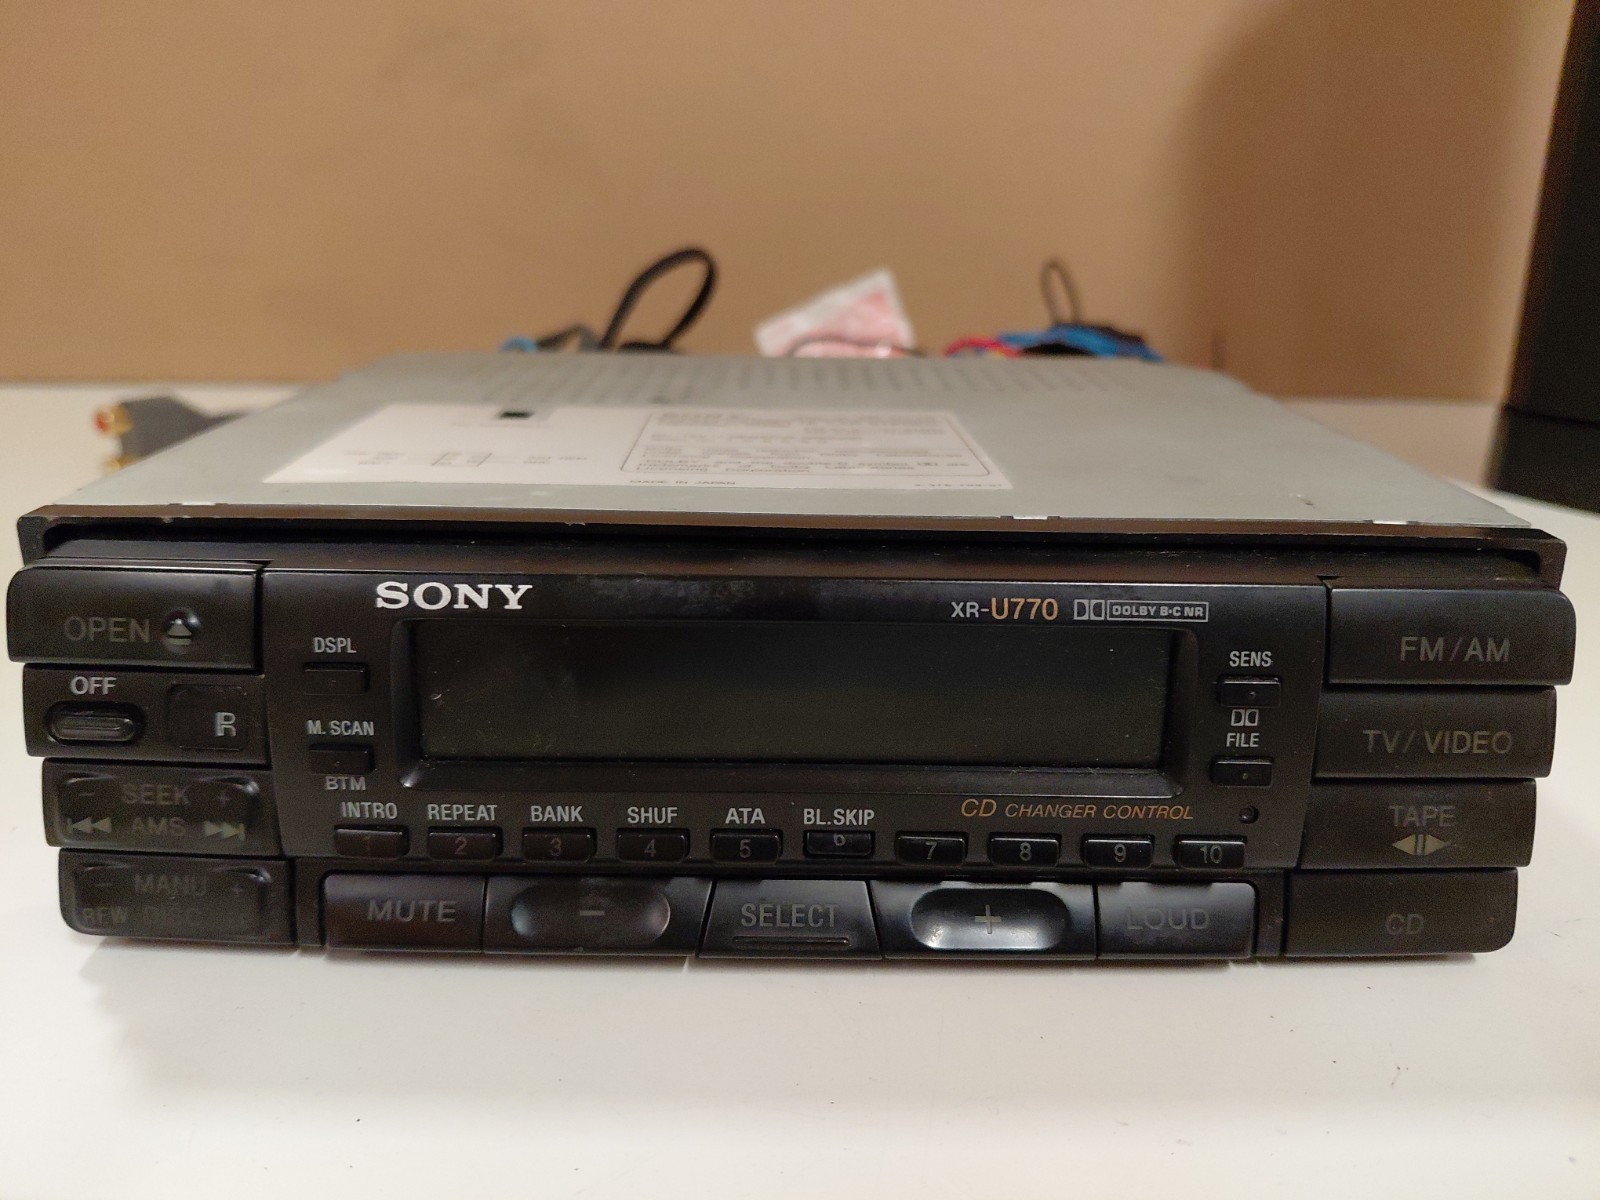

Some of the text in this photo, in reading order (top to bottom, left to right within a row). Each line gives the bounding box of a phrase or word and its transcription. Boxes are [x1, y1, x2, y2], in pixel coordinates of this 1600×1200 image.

[376, 581, 534, 610] SONY
[950, 597, 1059, 620] XR-U770
[1111, 604, 1157, 616] DOLBY
[1183, 606, 1205, 618] NR
[63, 616, 151, 644] OPEN
[313, 636, 357, 654] DSPL
[1228, 650, 1273, 668] SENS
[69, 675, 117, 696] OFF
[1226, 732, 1260, 748] FILE
[324, 775, 367, 791] BTM
[121, 783, 190, 806] SEEK
[340, 801, 398, 820] INTRO
[427, 803, 498, 822] REPEAT
[530, 805, 584, 823] BANK
[626, 806, 679, 824] SHUF
[725, 807, 766, 825] ATA
[961, 798, 1194, 821] CD CHANGER CONTROL
[1388, 804, 1456, 828] TAPE
[131, 816, 187, 837] AMS
[453, 836, 468, 855] 2
[550, 837, 563, 857] 3
[642, 838, 657, 858] 4
[738, 838, 751, 859] 5
[924, 840, 938, 860] 7
[1018, 841, 1033, 862] 8
[1113, 842, 1127, 863] 9
[1199, 844, 1223, 864] 10
[366, 900, 457, 924] MUTE
[740, 902, 840, 928] SELECT
[1126, 905, 1210, 931] LOUD
[1385, 913, 1425, 937] CD
